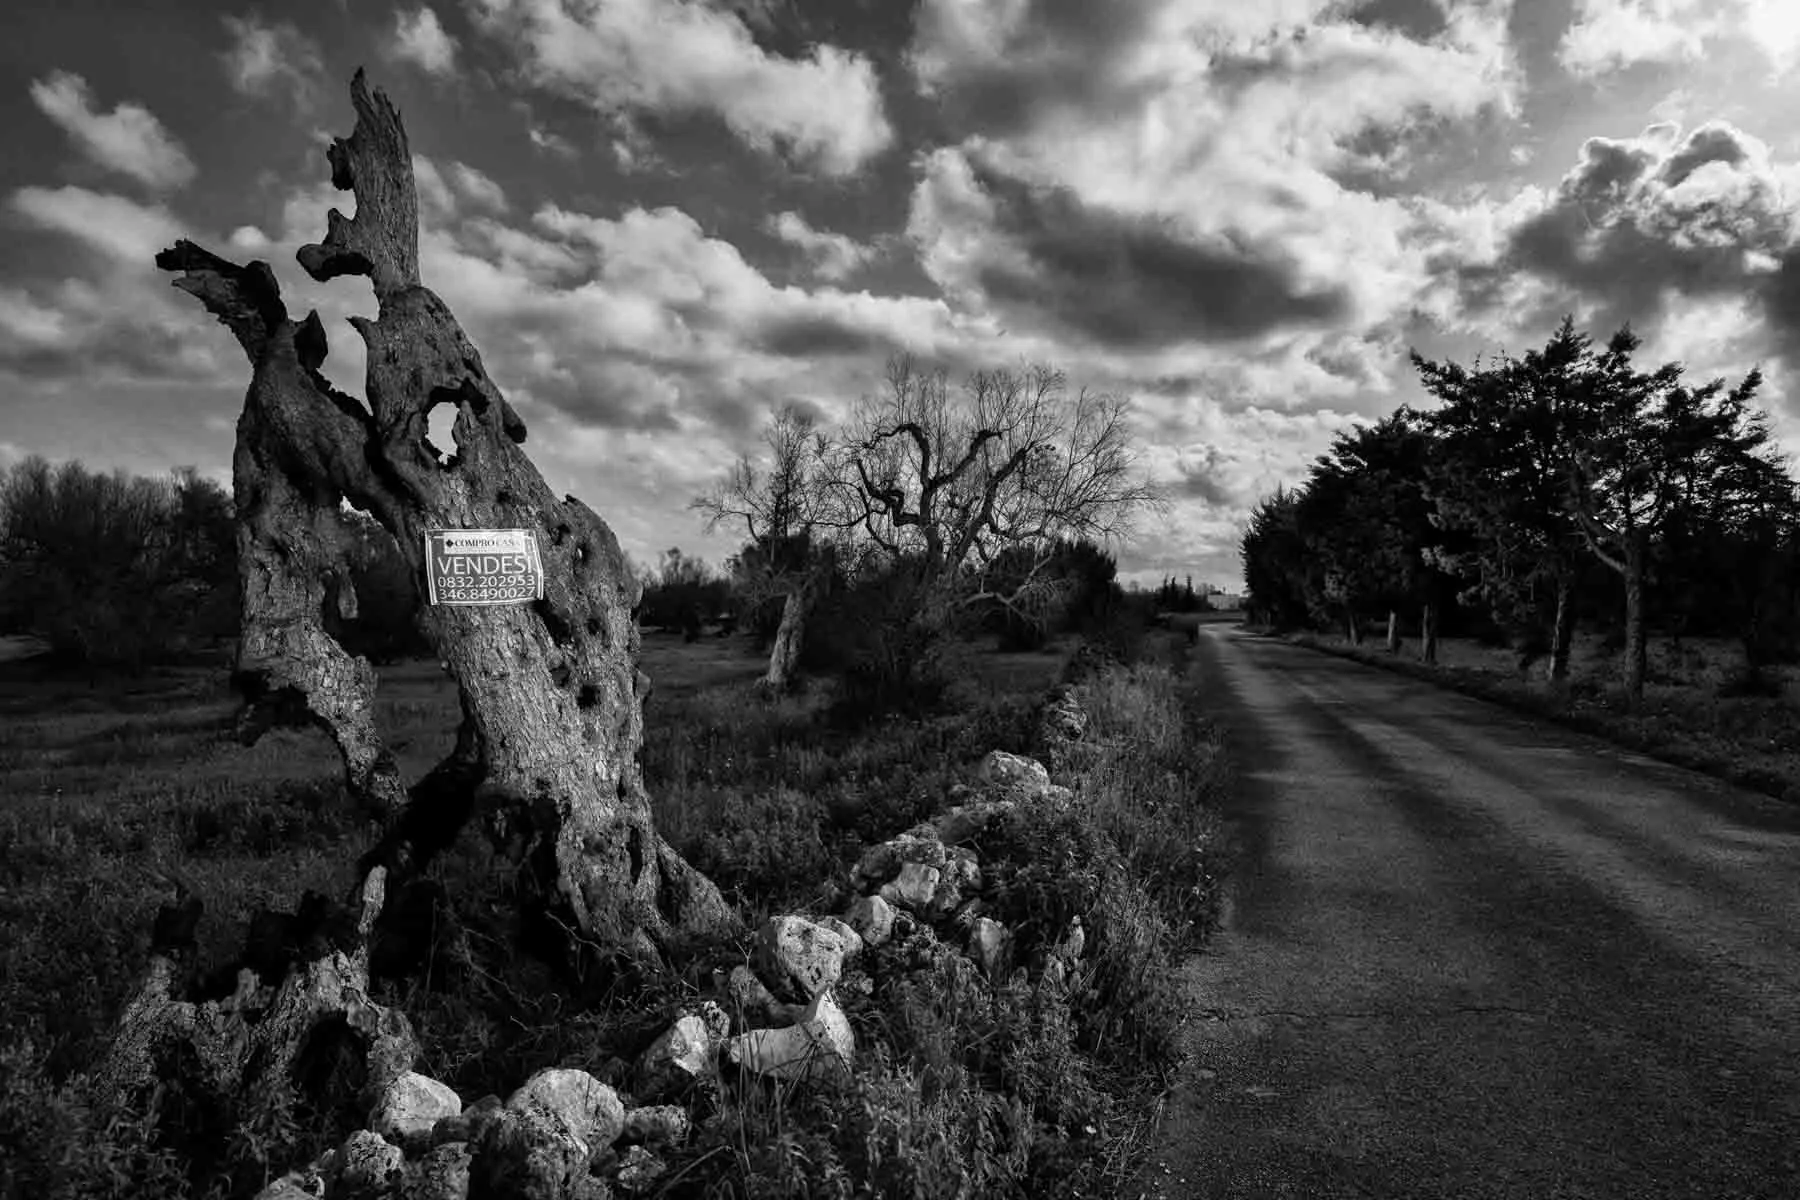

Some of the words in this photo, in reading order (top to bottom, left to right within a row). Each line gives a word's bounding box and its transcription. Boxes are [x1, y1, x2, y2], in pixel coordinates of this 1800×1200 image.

[438, 555, 533, 575] VENDESI
[438, 576, 536, 588] 0832.202953
[440, 587, 536, 600] 346.8490027
